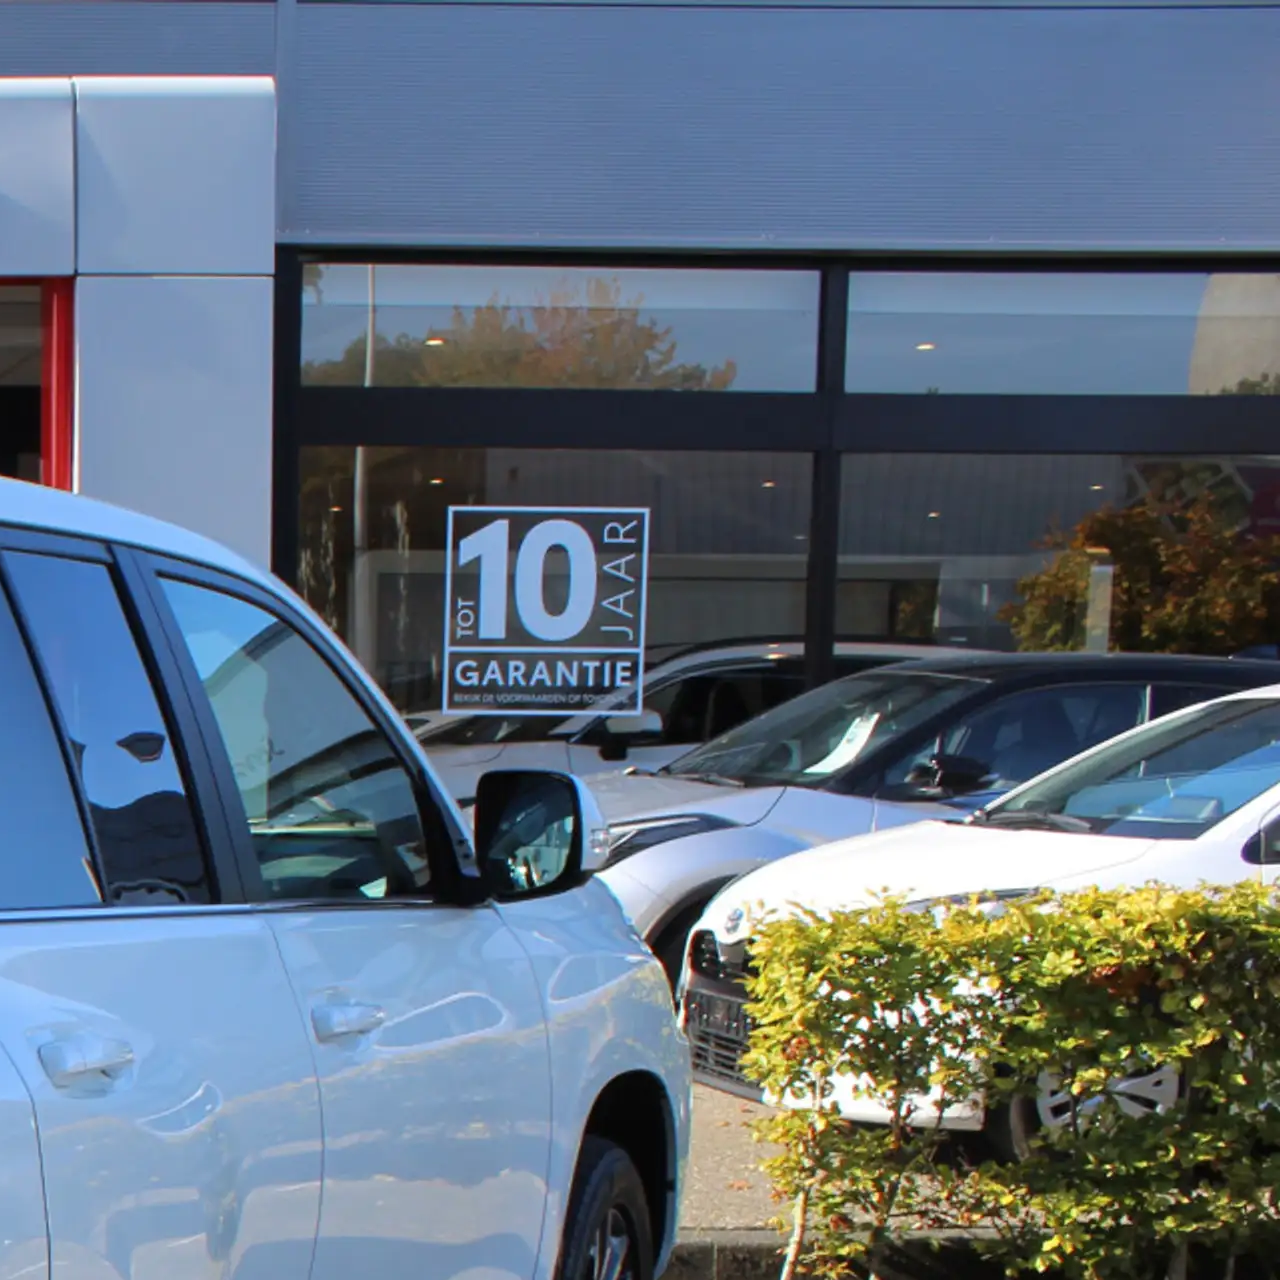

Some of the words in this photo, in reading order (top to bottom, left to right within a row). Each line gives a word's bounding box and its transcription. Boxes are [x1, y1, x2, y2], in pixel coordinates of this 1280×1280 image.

[457, 597, 476, 639] TOT
[458, 519, 598, 642] 10
[600, 520, 638, 641] JAAR
[453, 659, 633, 687] GARANTIE
